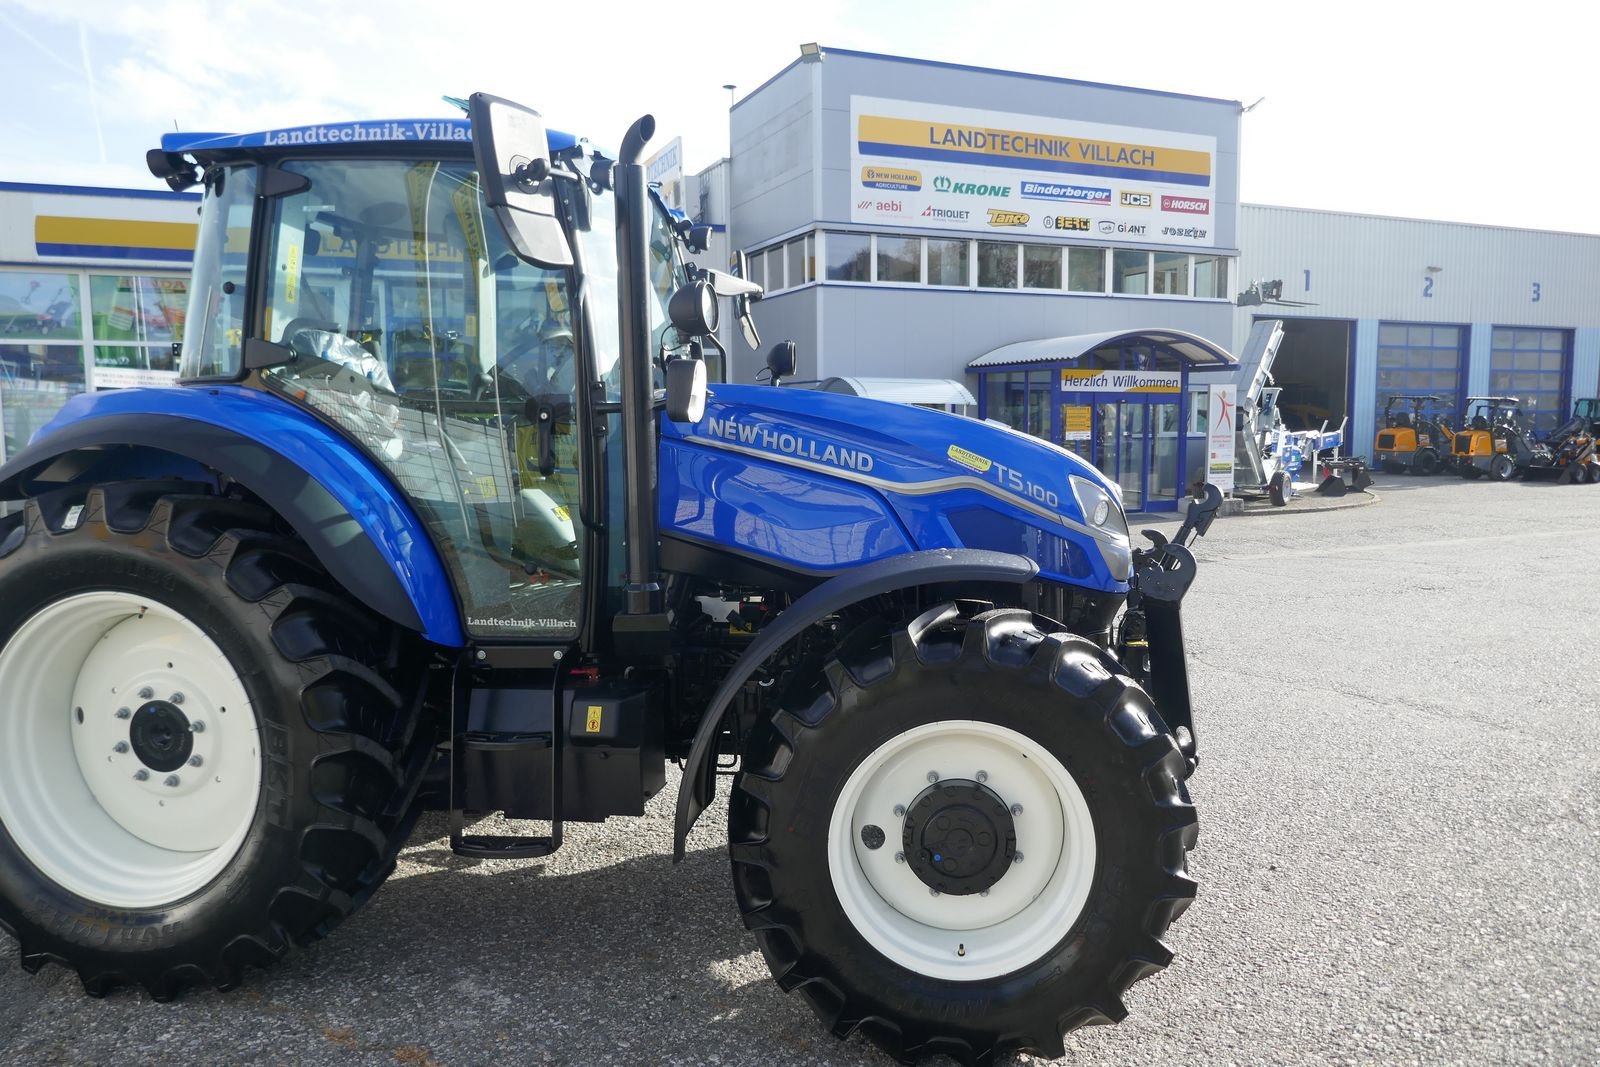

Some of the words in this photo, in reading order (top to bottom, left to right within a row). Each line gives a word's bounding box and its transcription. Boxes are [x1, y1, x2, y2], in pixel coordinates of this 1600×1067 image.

[929, 127, 1071, 158] LANDTECHNIK
[1078, 142, 1155, 167] VILLACH
[875, 172, 890, 181] NEW
[890, 173, 917, 182] HOLLAND
[875, 182, 908, 190] AGRICULTURE
[952, 182, 1011, 198] KRONE
[1023, 183, 1109, 200] Binderberger
[876, 201, 902, 212] aebi
[1121, 193, 1151, 206] JCB
[1171, 199, 1207, 212] HORSCH
[987, 208, 1030, 227] Tanco
[1303, 269, 1310, 291] 1
[1423, 277, 1434, 298] 2
[1532, 282, 1541, 302] 3
[1064, 374, 1108, 387] Herzlich
[1112, 375, 1179, 388] Willkommen
[708, 418, 758, 444] NEW
[762, 430, 874, 473] HOLLAND
[467, 616, 577, 628] Landtechnik-Villach
